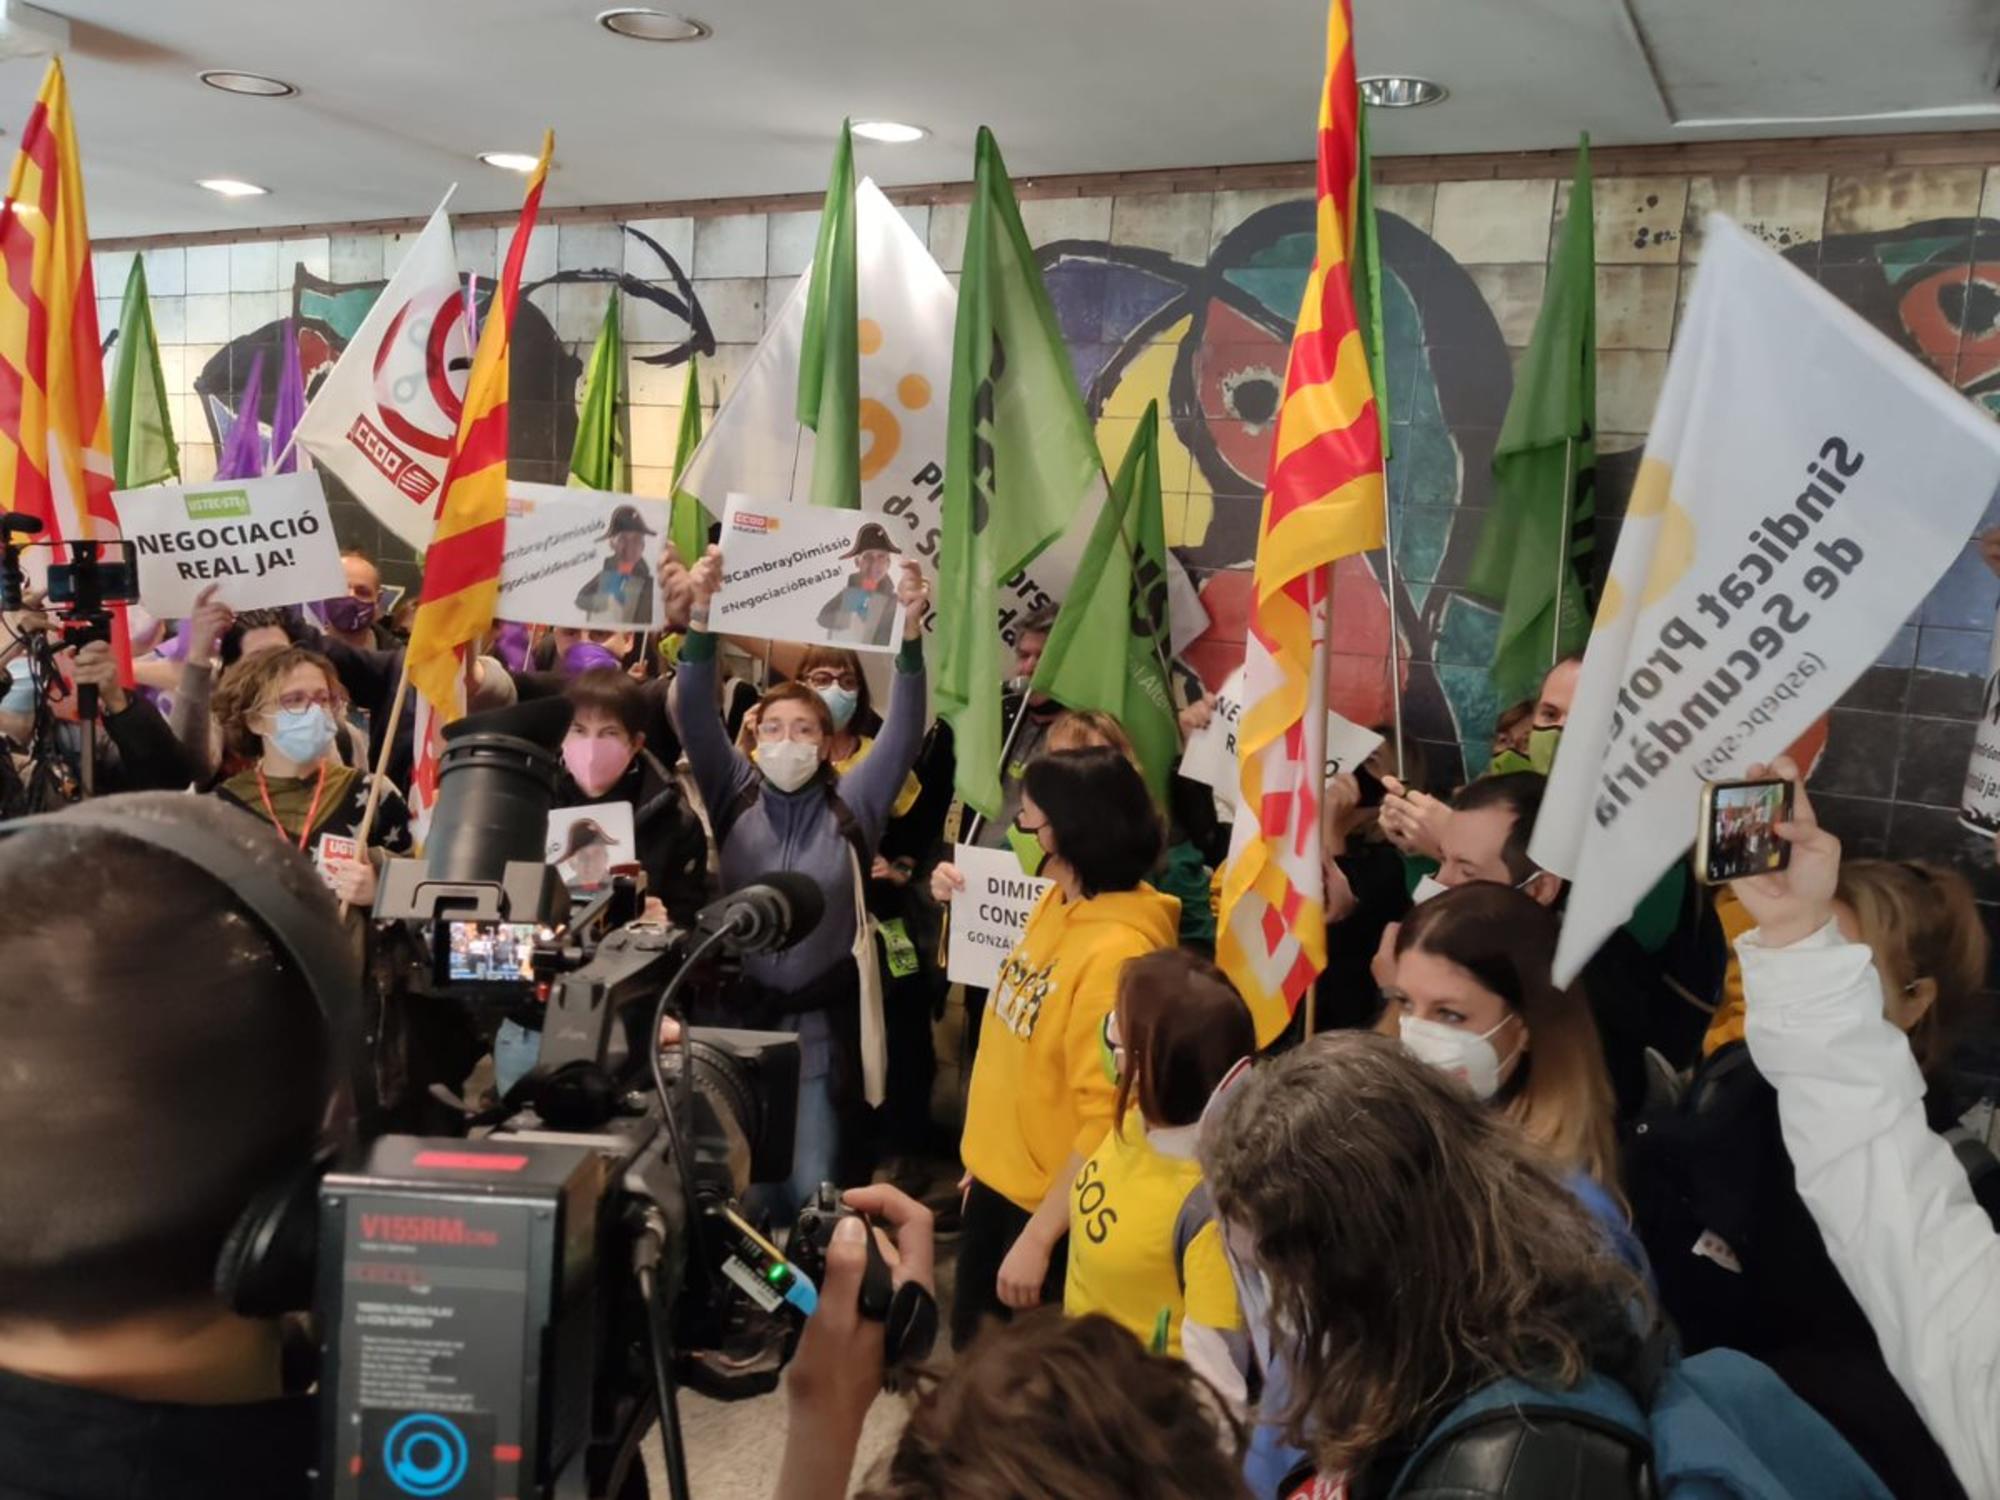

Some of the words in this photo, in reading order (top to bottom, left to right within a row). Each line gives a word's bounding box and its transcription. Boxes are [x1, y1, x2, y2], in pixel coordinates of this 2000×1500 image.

[355, 422, 402, 475] CCOO
[136, 510, 320, 555] NEGOCIACIÓ
[177, 555, 249, 580] REAL
[255, 548, 296, 577] JA!
[1076, 1160, 1118, 1244] SOS
